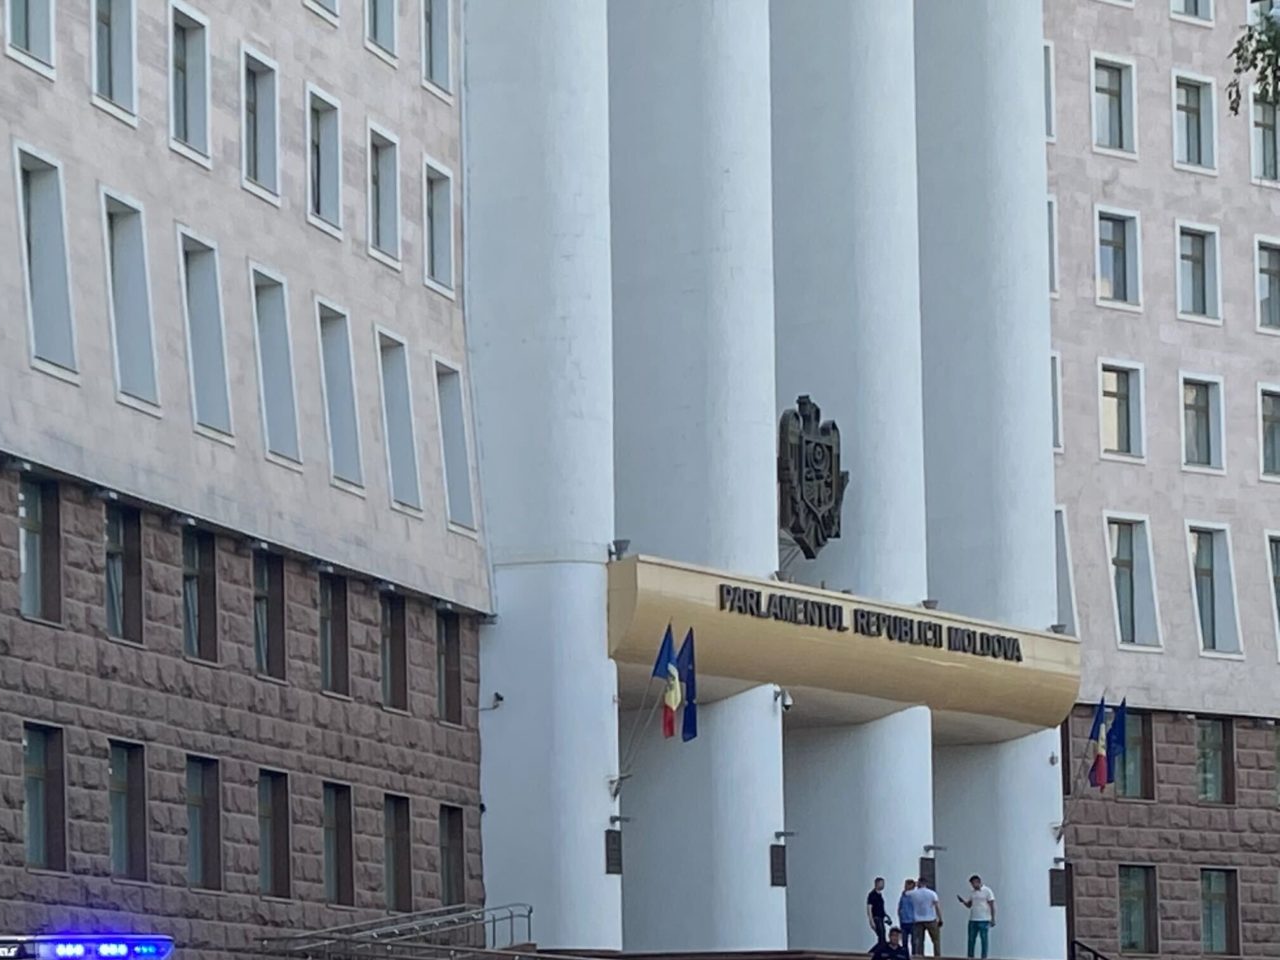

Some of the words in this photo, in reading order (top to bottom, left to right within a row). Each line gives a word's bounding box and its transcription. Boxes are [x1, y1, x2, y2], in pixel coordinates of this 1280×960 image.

[719, 583, 849, 631] PARLAMENTUL
[853, 608, 943, 648] REPUBLICII
[947, 625, 1023, 662] MOLDOVA
